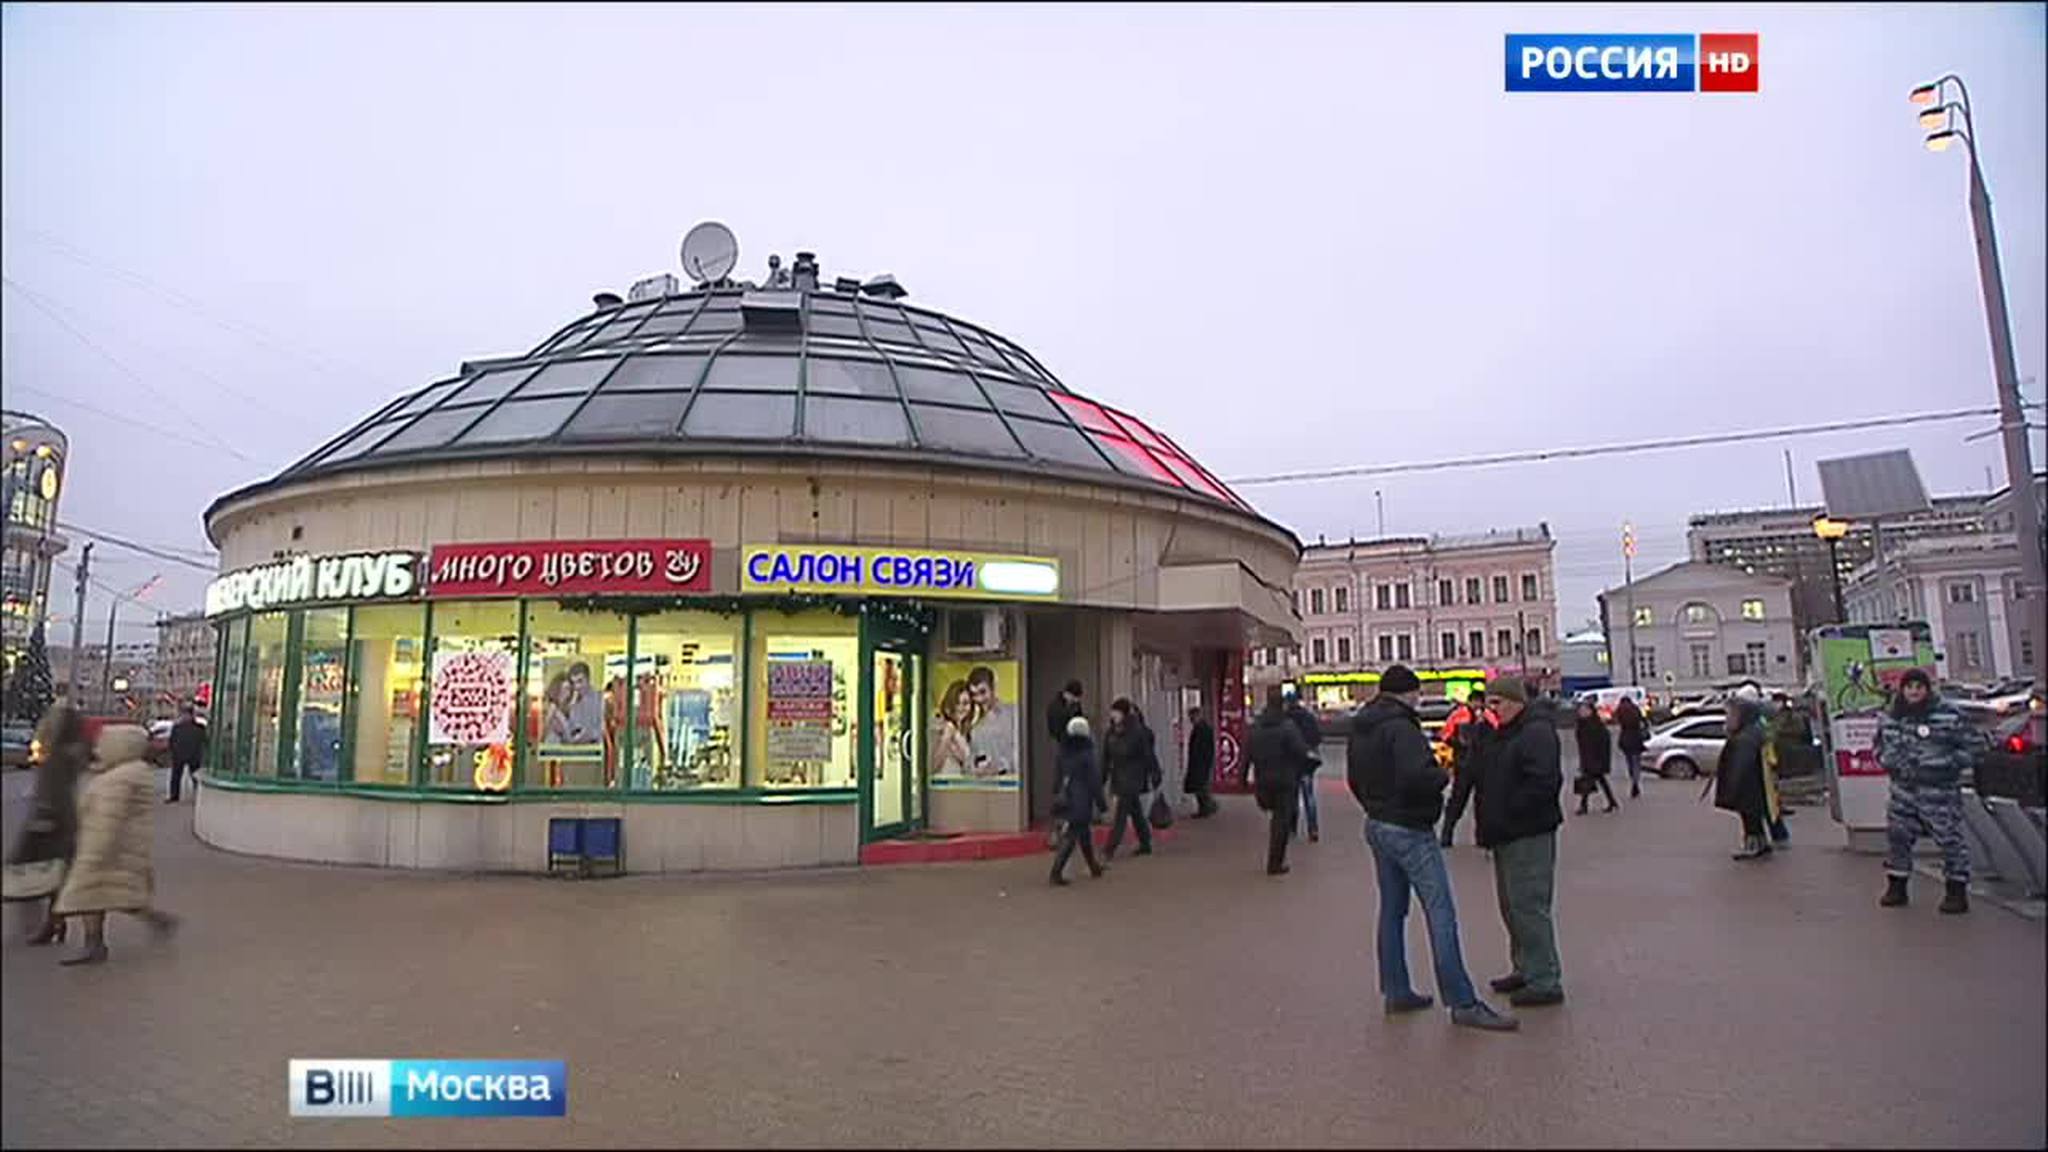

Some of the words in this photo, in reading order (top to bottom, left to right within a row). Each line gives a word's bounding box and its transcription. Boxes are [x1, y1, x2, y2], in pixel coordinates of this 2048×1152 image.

[317, 554, 414, 598] КЛУБ
[748, 553, 862, 583] САЛОН
[872, 556, 975, 588] СВЯЗИ
